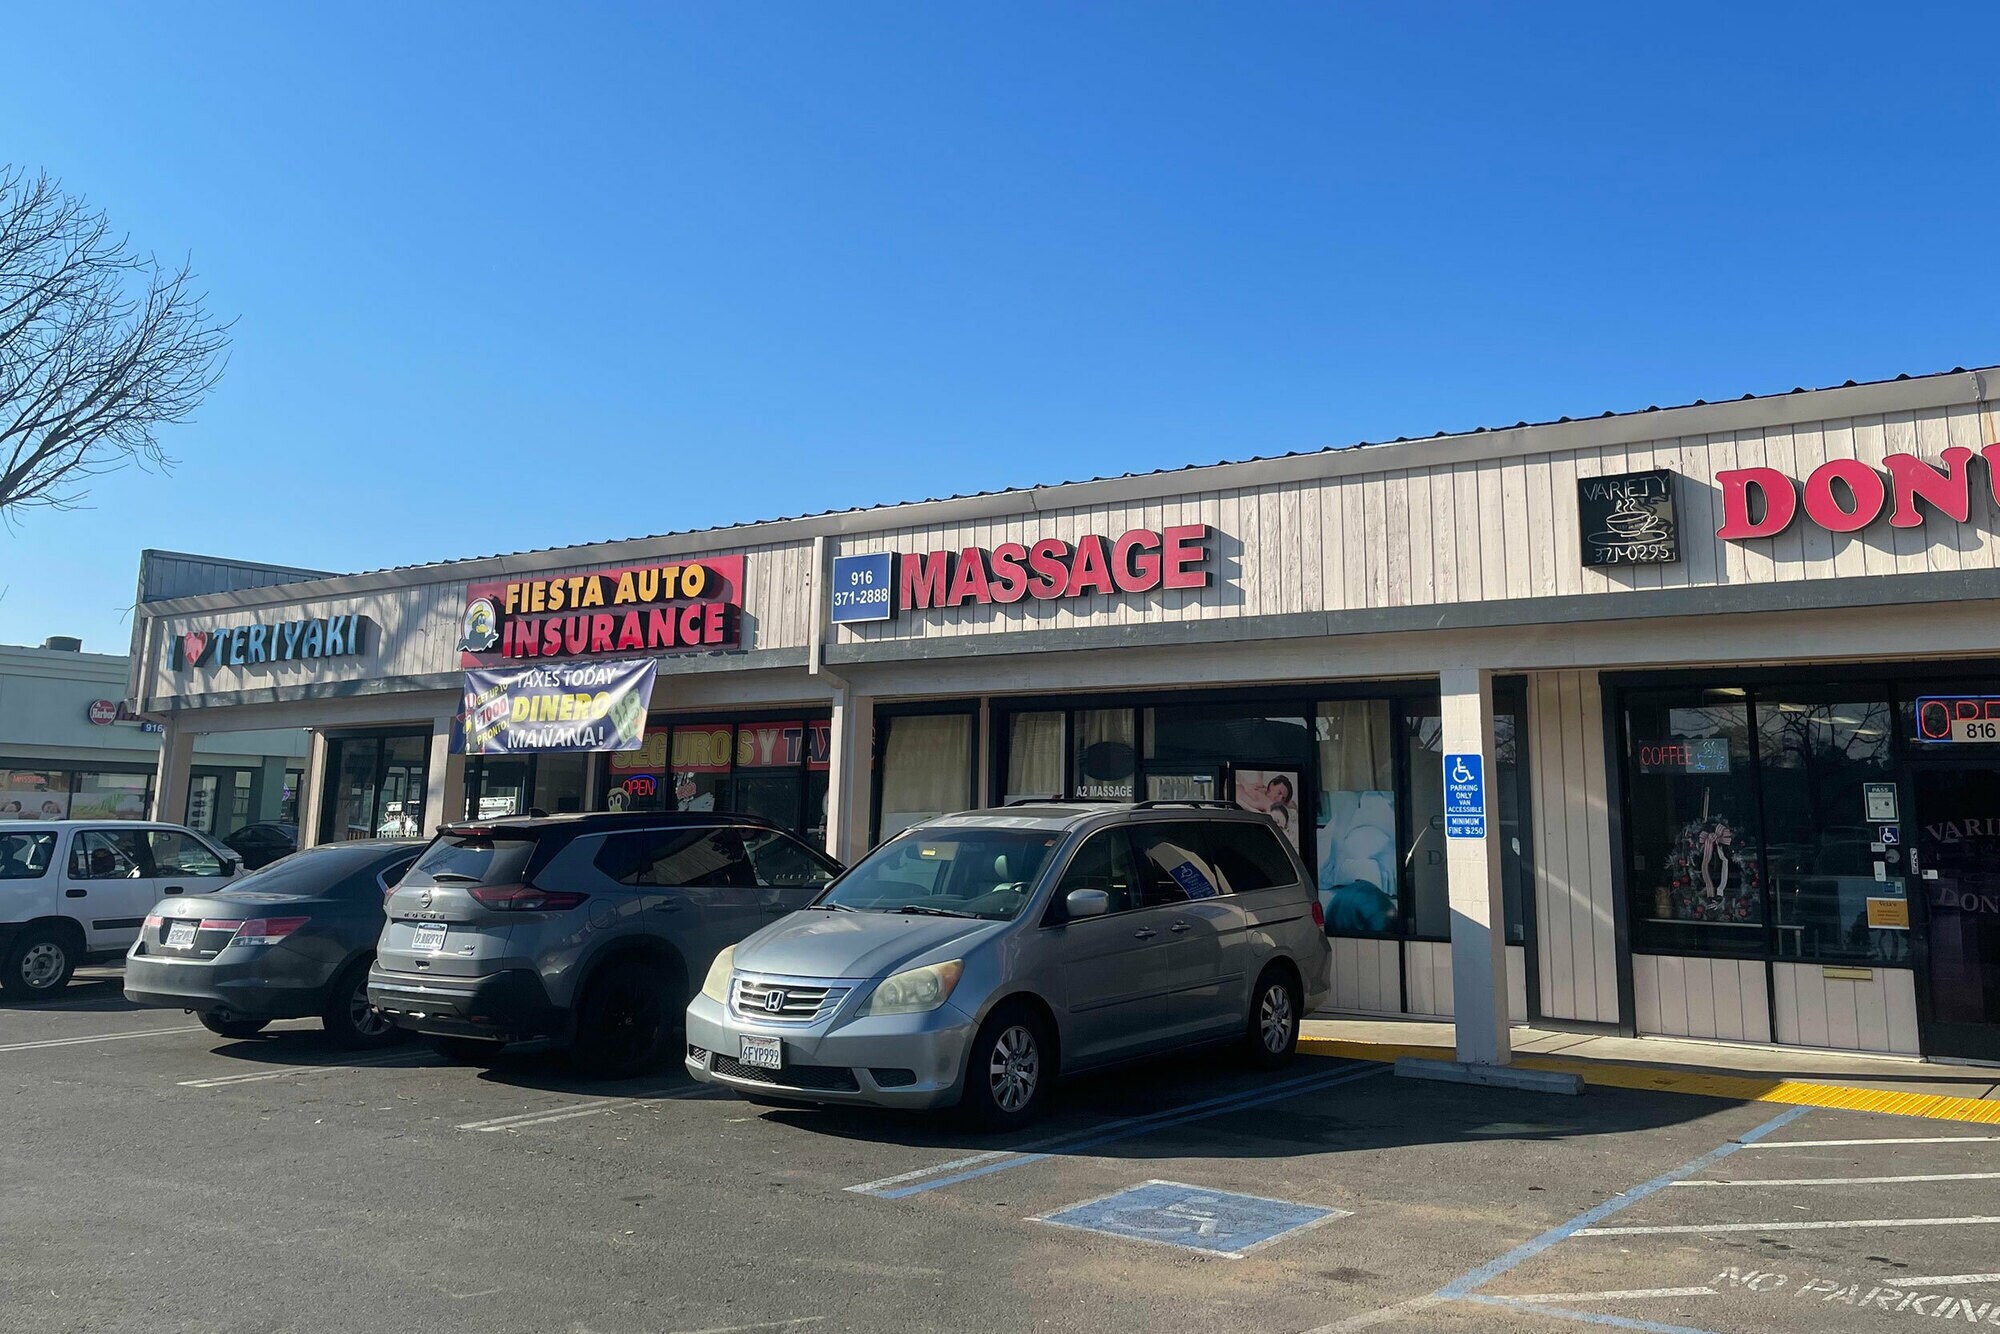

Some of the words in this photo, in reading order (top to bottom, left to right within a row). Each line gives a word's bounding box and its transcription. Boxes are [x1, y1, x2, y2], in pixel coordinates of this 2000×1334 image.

[1583, 475, 1669, 501] VARIETY
[1715, 442, 2000, 540] DON
[1594, 544, 1669, 563] 371-0295
[850, 570, 873, 587] 916
[900, 523, 1207, 611] MASSAGE
[505, 575, 605, 616] FIESTA
[613, 563, 706, 604] AUTO
[834, 587, 888, 607] 371-2888
[165, 633, 178, 671] I
[212, 614, 360, 666] TERIYAKI
[502, 602, 726, 659] INSURANCE
[517, 670, 560, 689] TAXES
[563, 667, 617, 687] TODAY
[476, 693, 489, 706] GET
[489, 687, 500, 698] UP
[511, 691, 610, 723] DINERO
[475, 697, 508, 726] $1000
[1921, 700, 2000, 738] OP
[145, 723, 163, 732] 916
[476, 718, 510, 745] PRONTO!
[507, 725, 604, 750] MAÑANA!
[1966, 722, 1996, 738] 816
[757, 728, 779, 765] Y
[1641, 745, 1694, 766] COFFEE
[623, 779, 655, 796] OPEN
[1076, 787, 1087, 797] A2
[1089, 785, 1133, 797] MASSAGE
[1450, 784, 1478, 792] PARKING
[1465, 826, 1484, 835] $250
[1925, 817, 2000, 843] VARI
[742, 1046, 779, 1063] 6FYP999
[1708, 1266, 1788, 1292] NO
